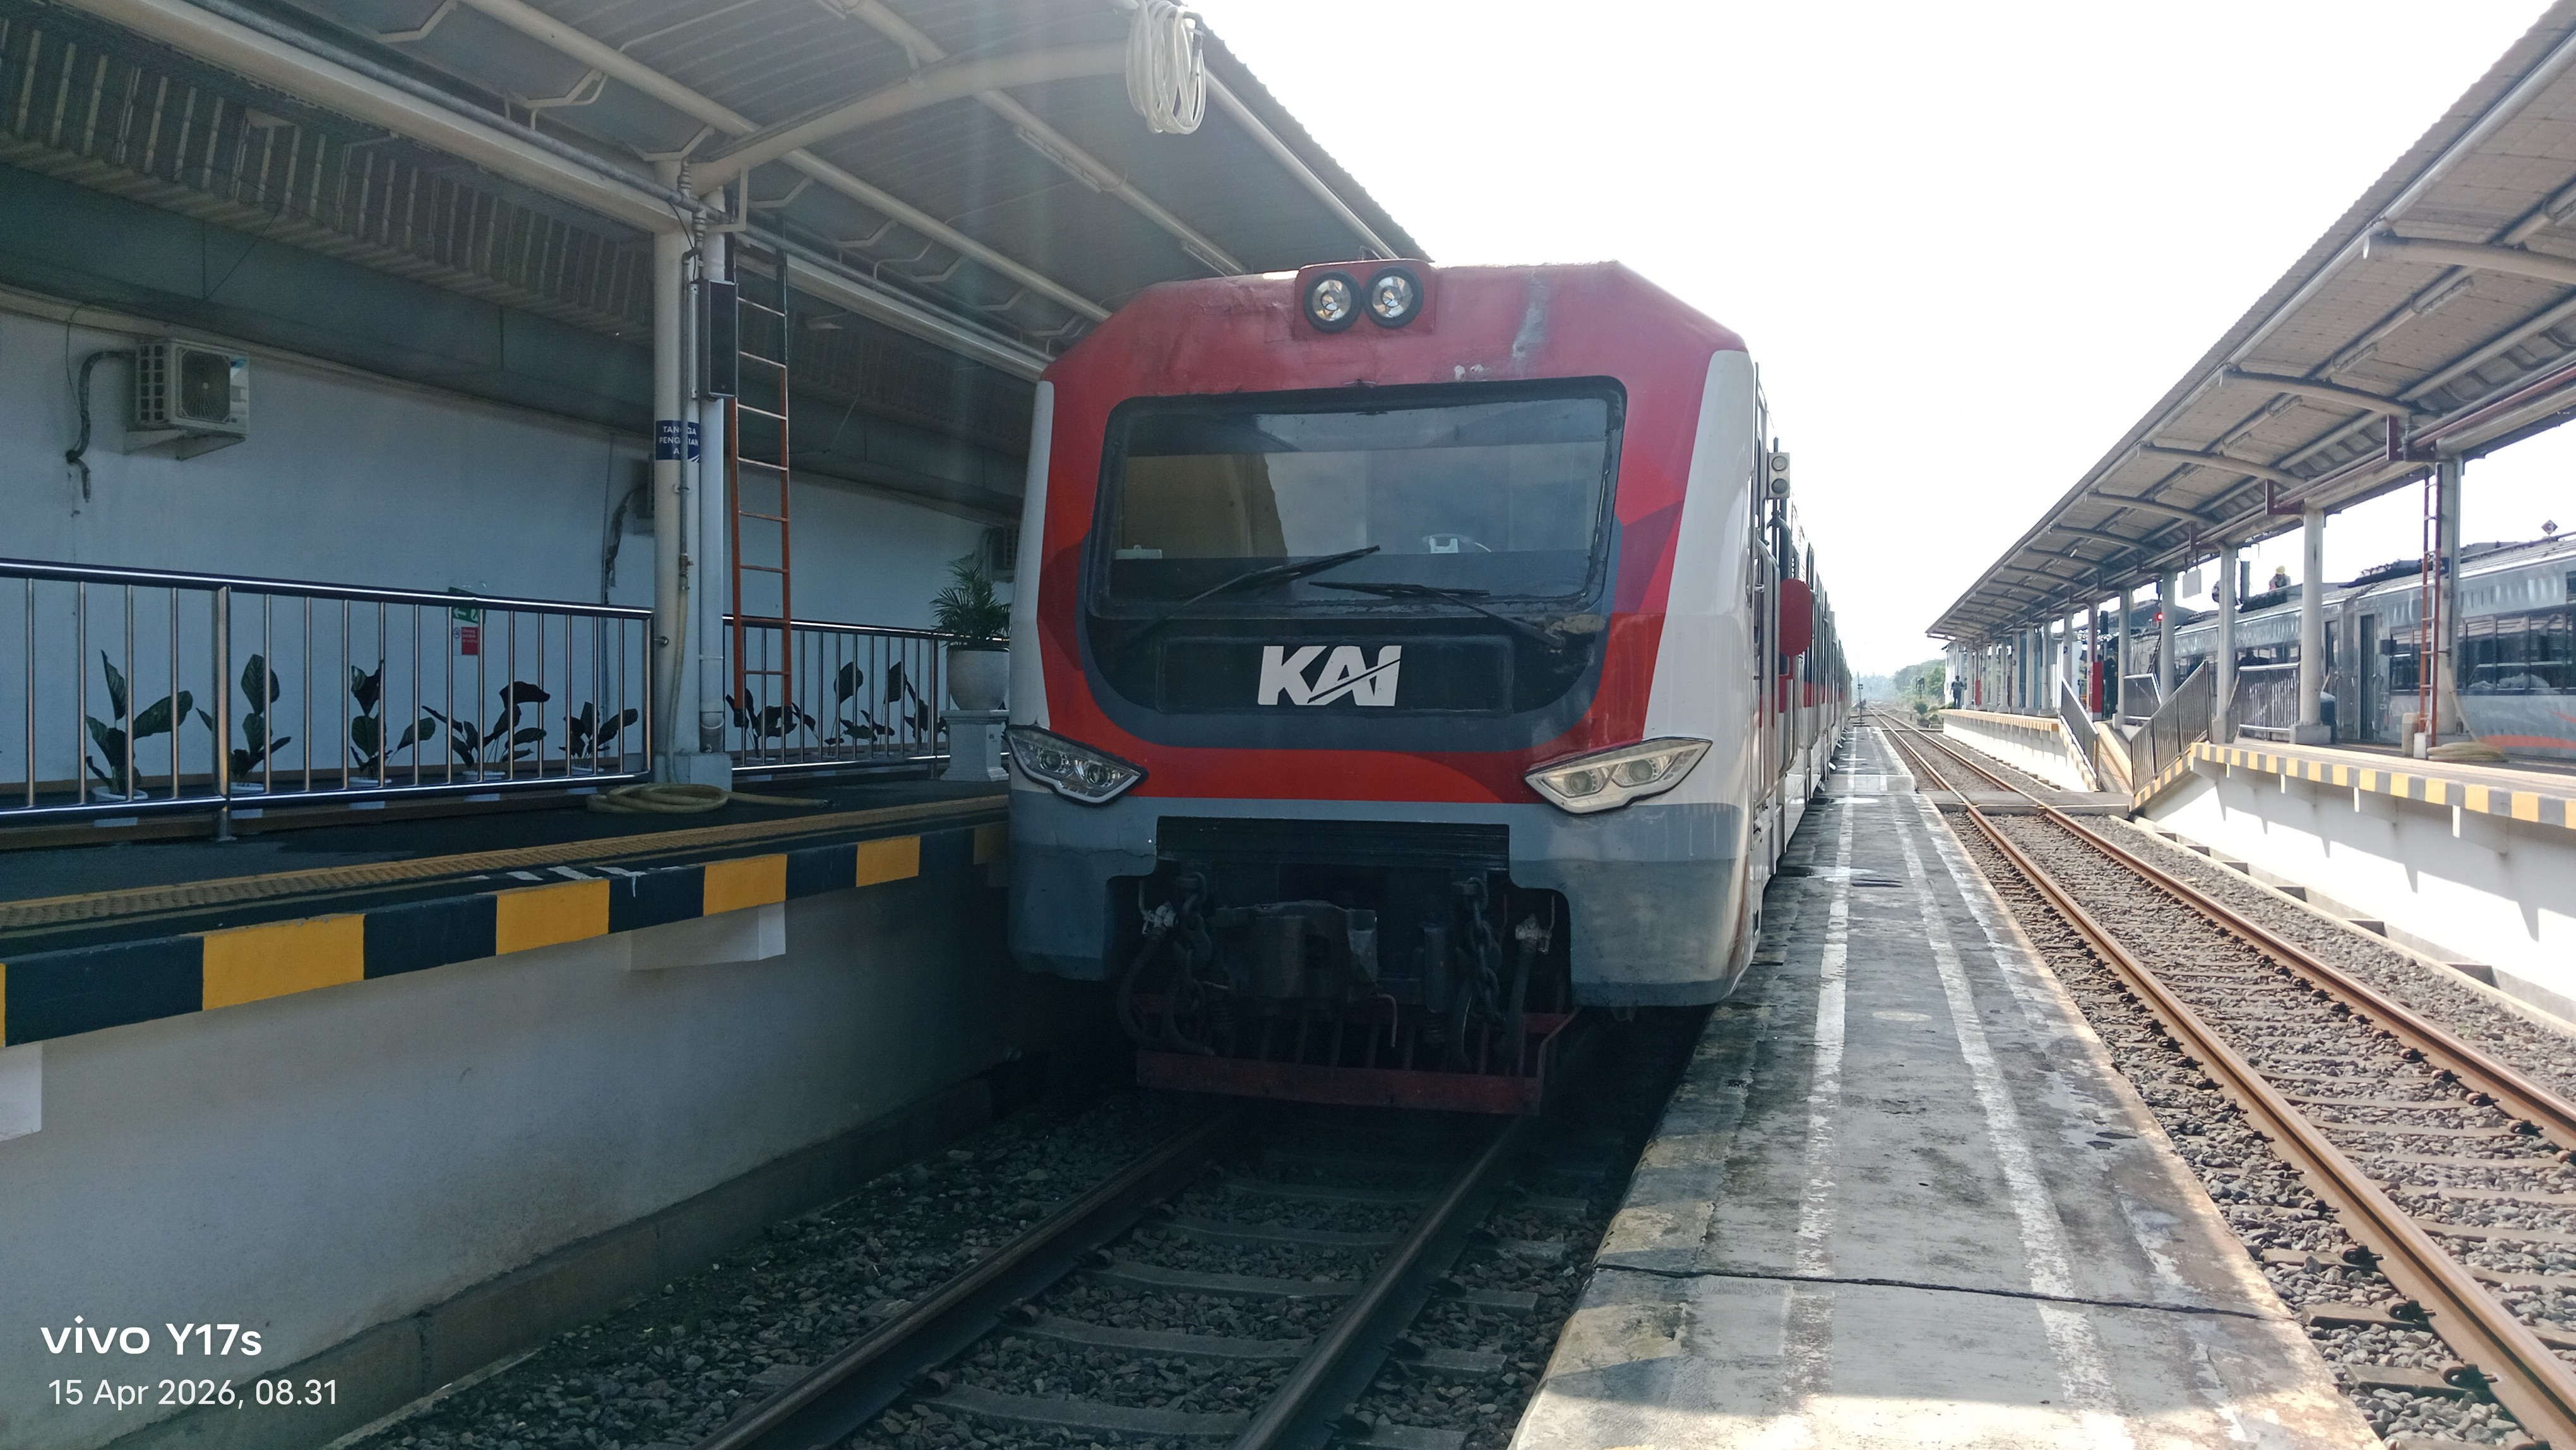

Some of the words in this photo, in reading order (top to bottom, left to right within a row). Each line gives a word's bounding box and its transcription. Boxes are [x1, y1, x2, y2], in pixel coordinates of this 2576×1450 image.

[663, 426, 696, 435] TANGA
[659, 437, 699, 446] PENGIAN
[1258, 645, 1402, 707] KAI
